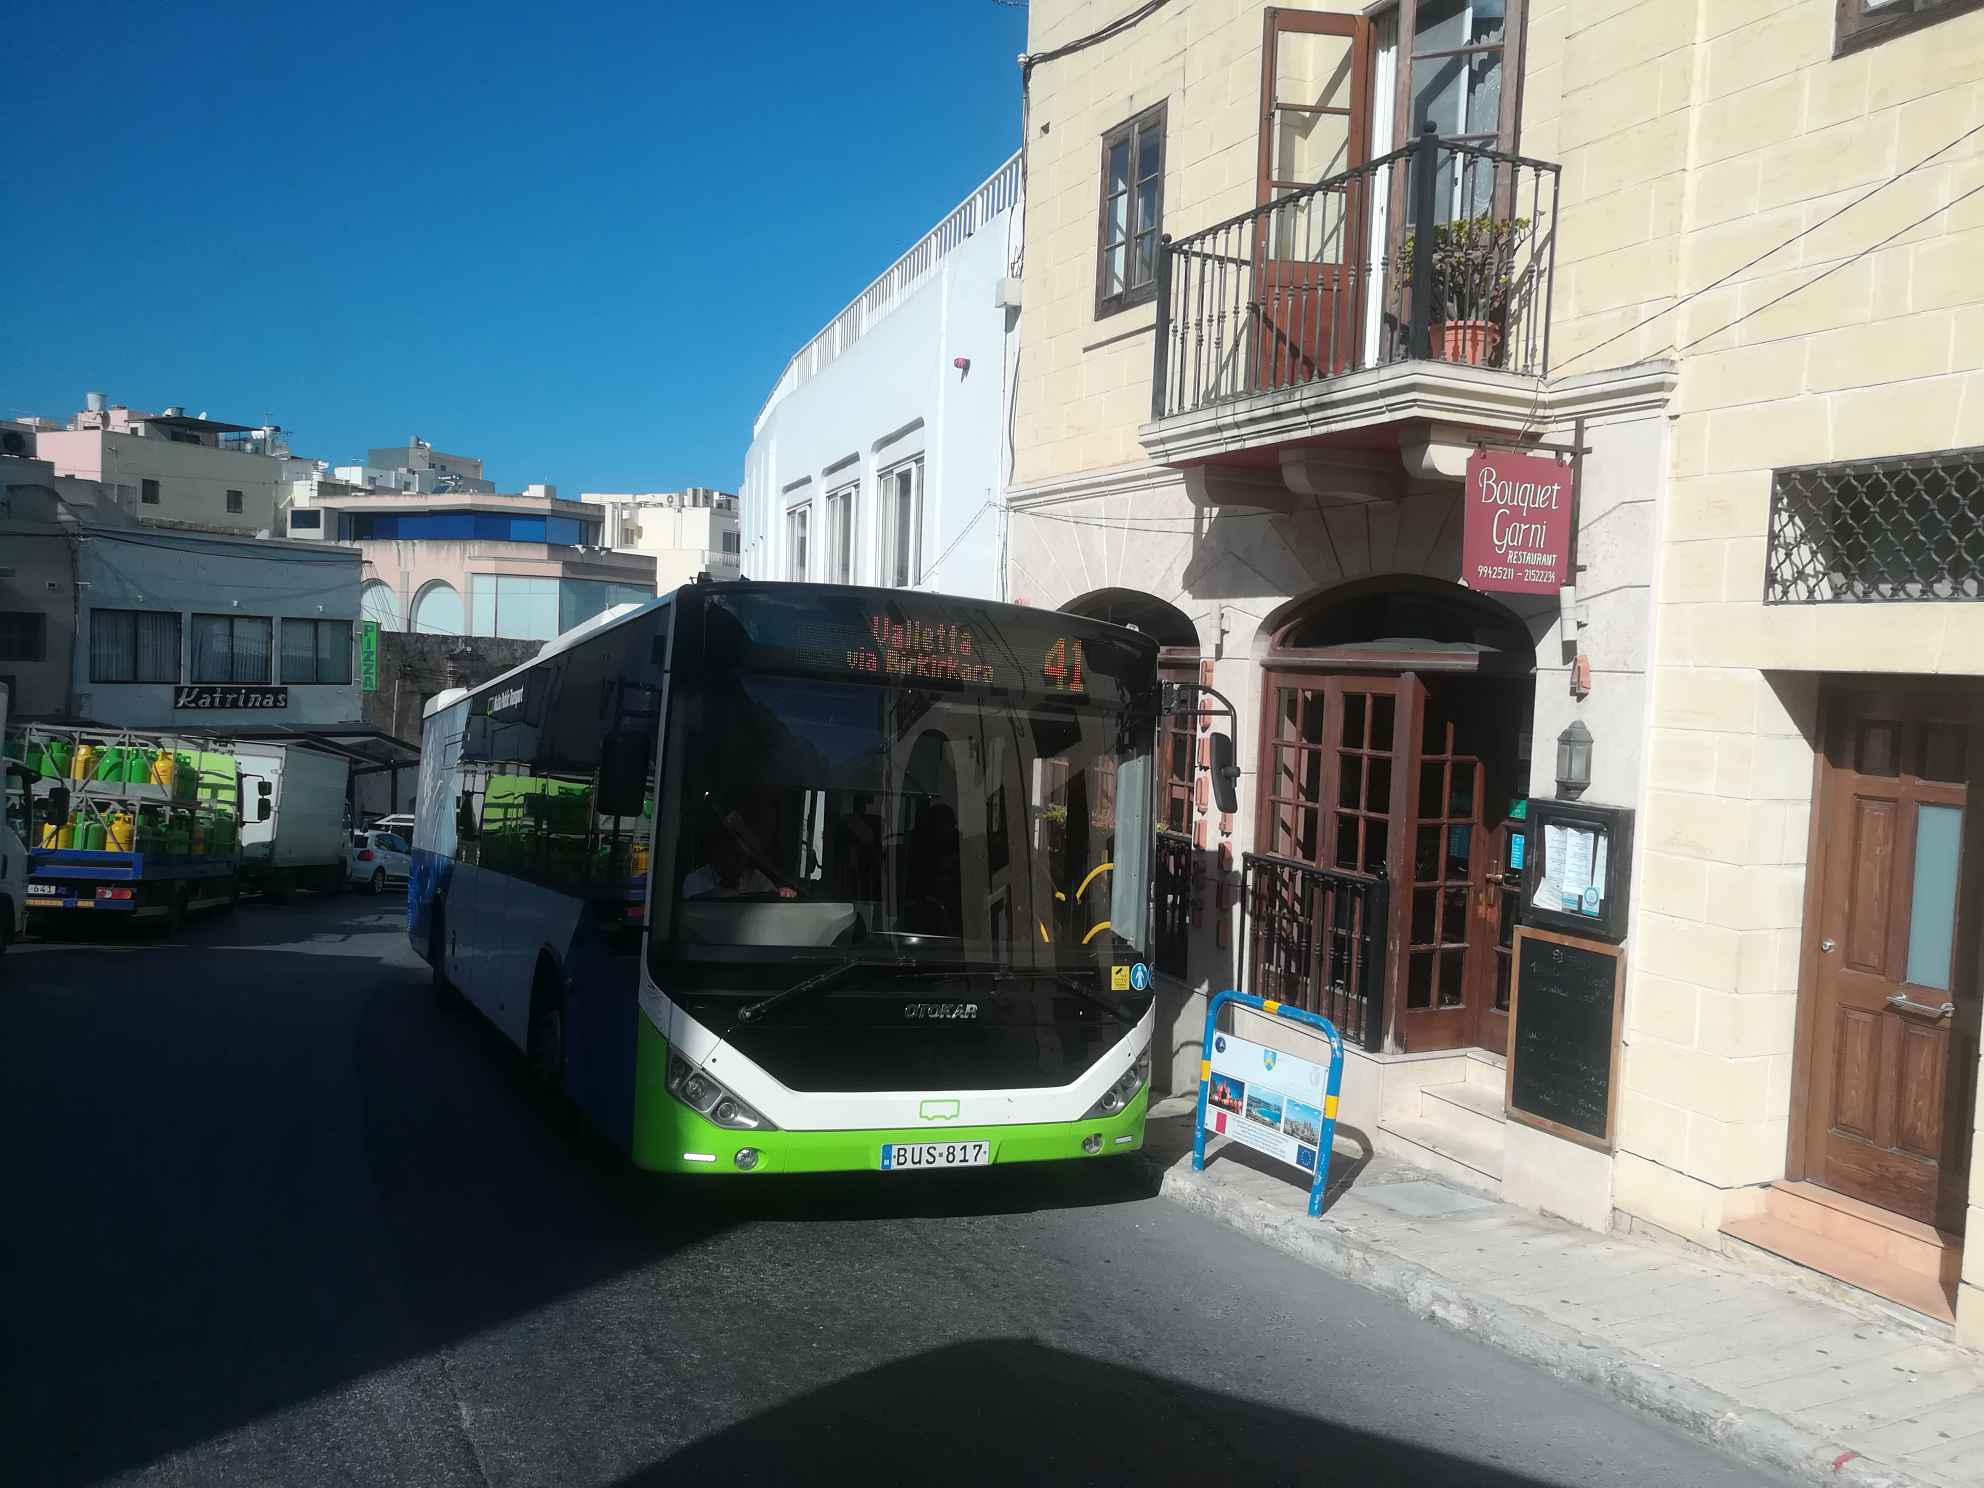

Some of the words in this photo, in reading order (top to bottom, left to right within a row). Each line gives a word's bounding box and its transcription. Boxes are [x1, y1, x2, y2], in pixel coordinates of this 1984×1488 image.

[1479, 467, 1561, 517] Bouquet
[1492, 508, 1548, 554] Garni
[1507, 549, 1558, 567] RESTAURANT
[1477, 565, 1514, 581] 99425211
[1523, 569, 1556, 583] 21522234
[873, 615, 973, 656] Valletta
[362, 623, 376, 690] PIZZA
[847, 646, 877, 672] via
[1043, 638, 1085, 692] 41
[176, 686, 288, 708] Katrinas
[904, 1003, 979, 1019] OTOKAR
[896, 1145, 938, 1166] BUS
[945, 1143, 984, 1165] 817
